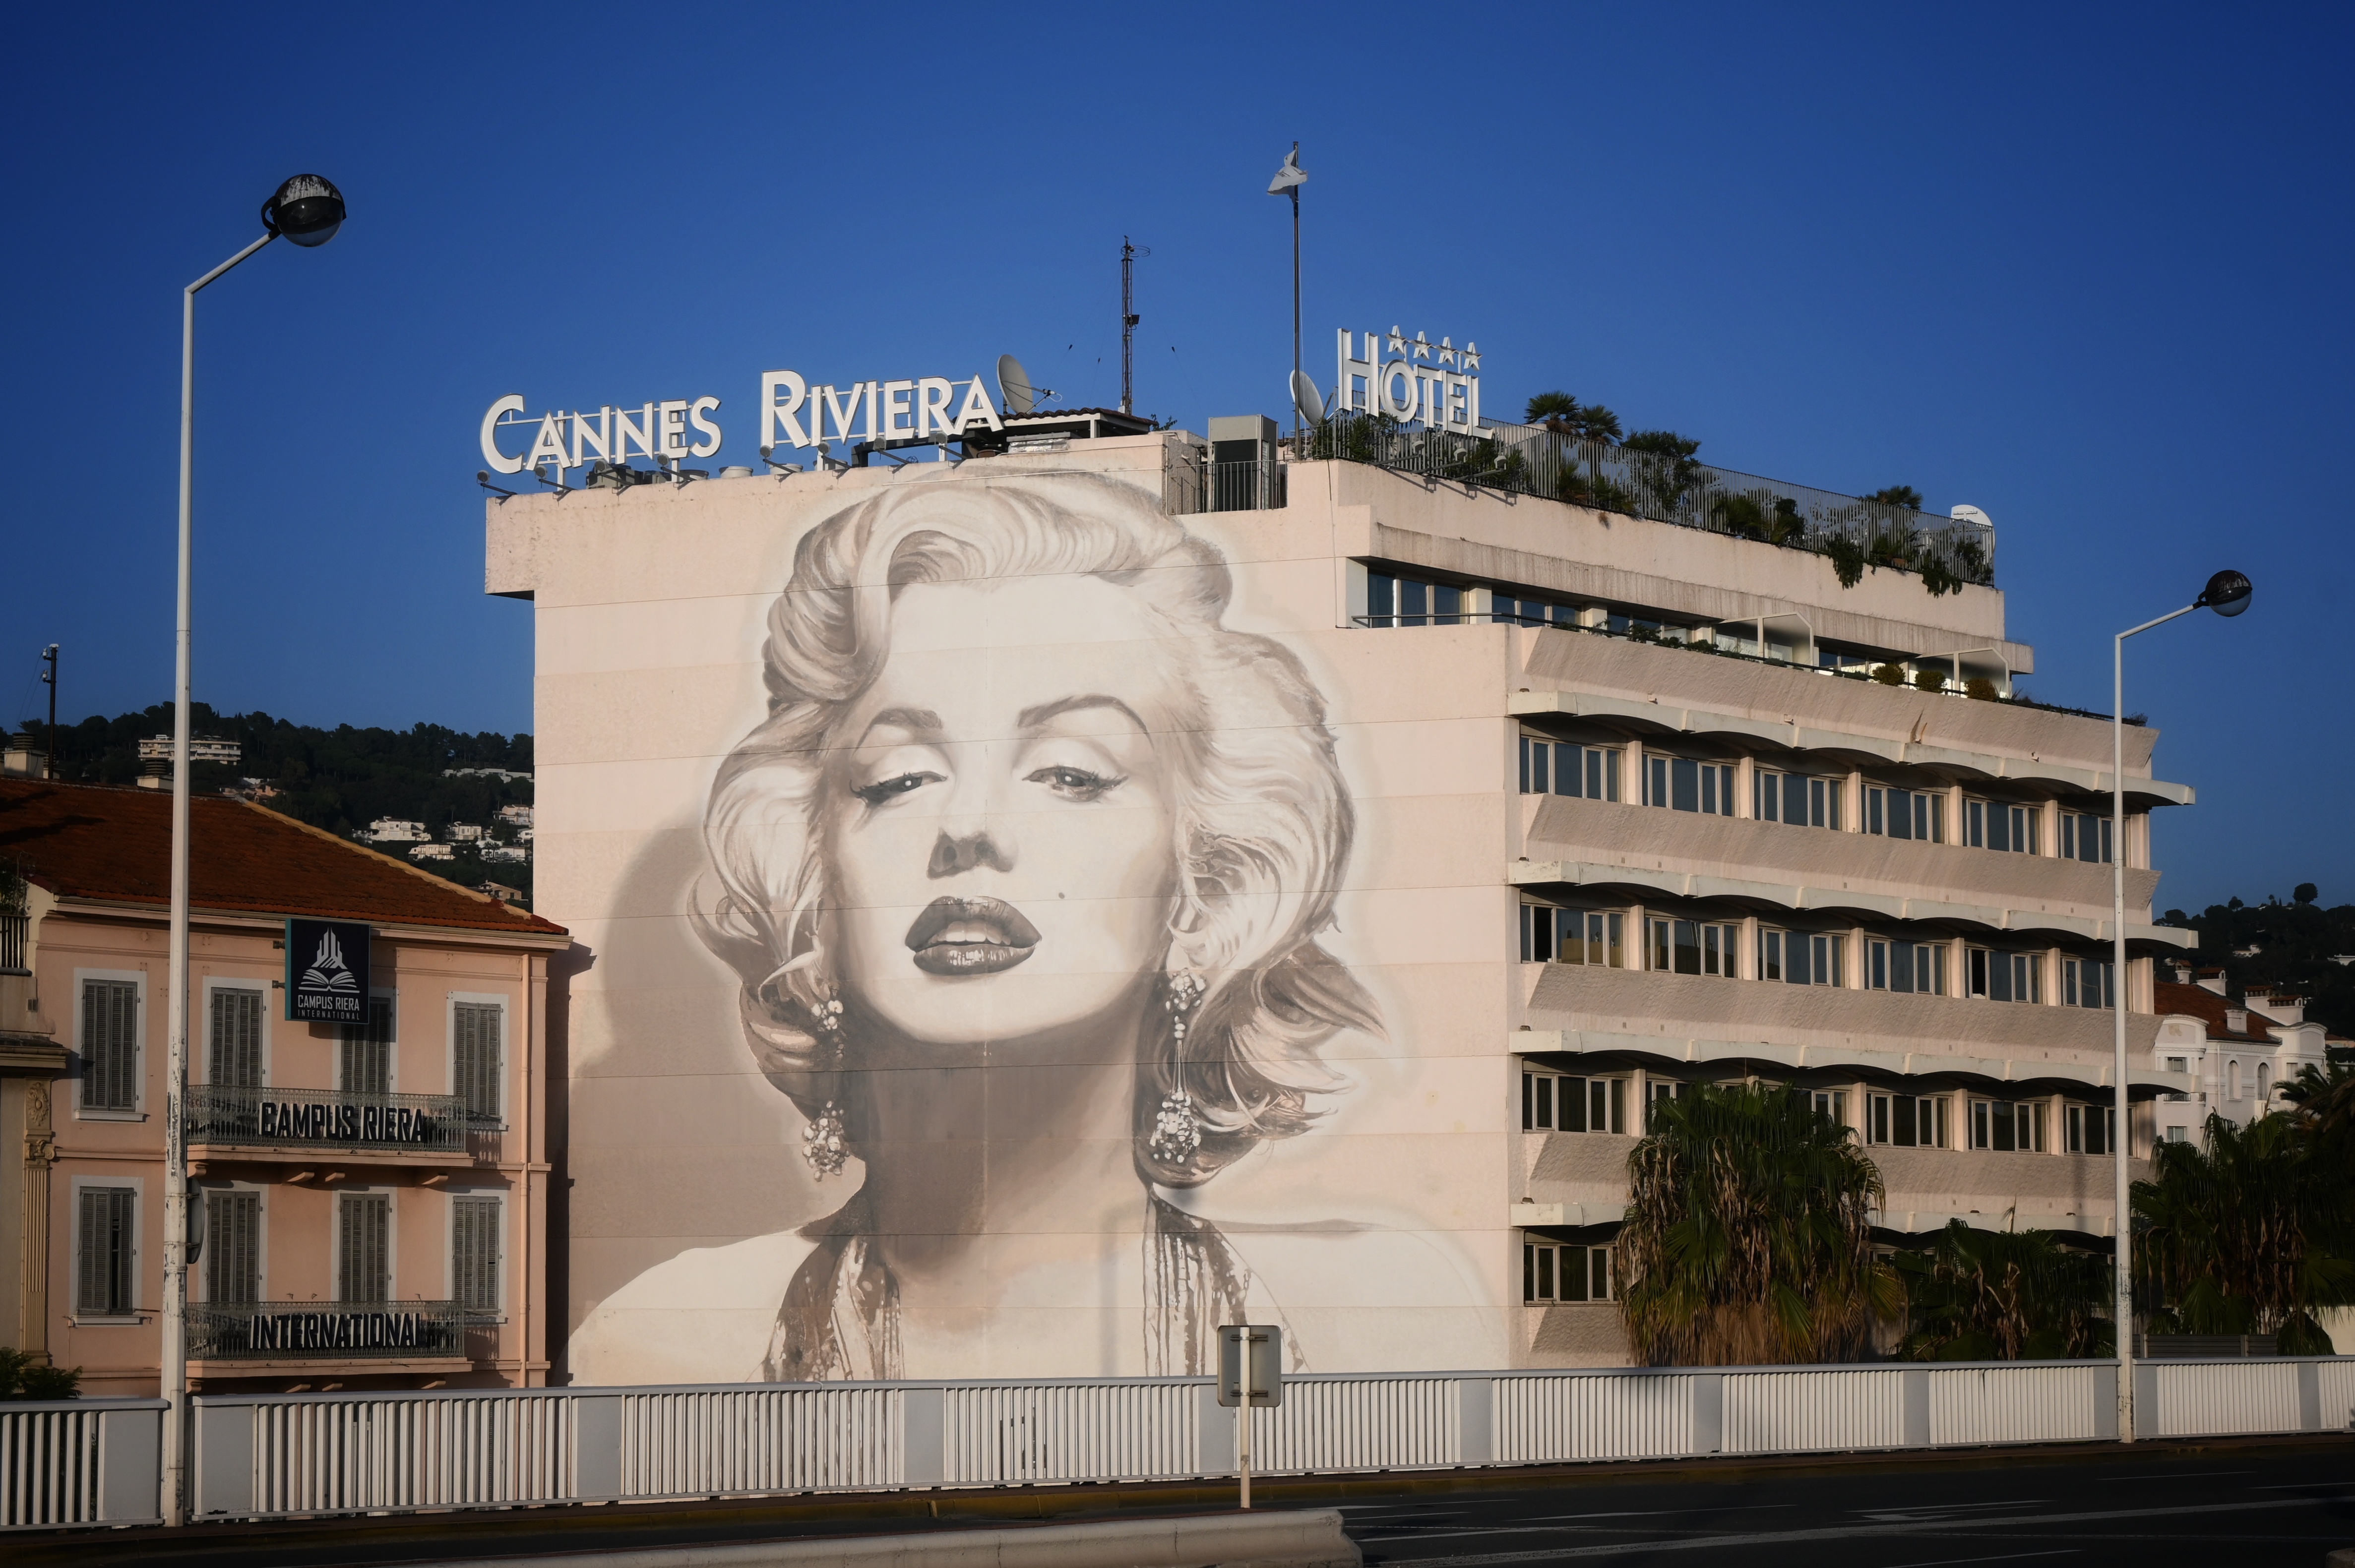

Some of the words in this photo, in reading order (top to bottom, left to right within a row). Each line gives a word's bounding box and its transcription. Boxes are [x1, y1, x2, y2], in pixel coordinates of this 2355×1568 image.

[1337, 328, 1493, 439] HOTEL
[480, 392, 722, 474] CANNES
[760, 369, 1004, 449] RIVIERA
[298, 994, 333, 1009] CAMPUS
[335, 997, 360, 1011] RIERA
[298, 1009, 360, 1020] INTERNATIONAL
[258, 1102, 355, 1140] CAMPUS
[361, 1106, 425, 1142] RIERA
[250, 1313, 427, 1349] INTERNATIONAL
